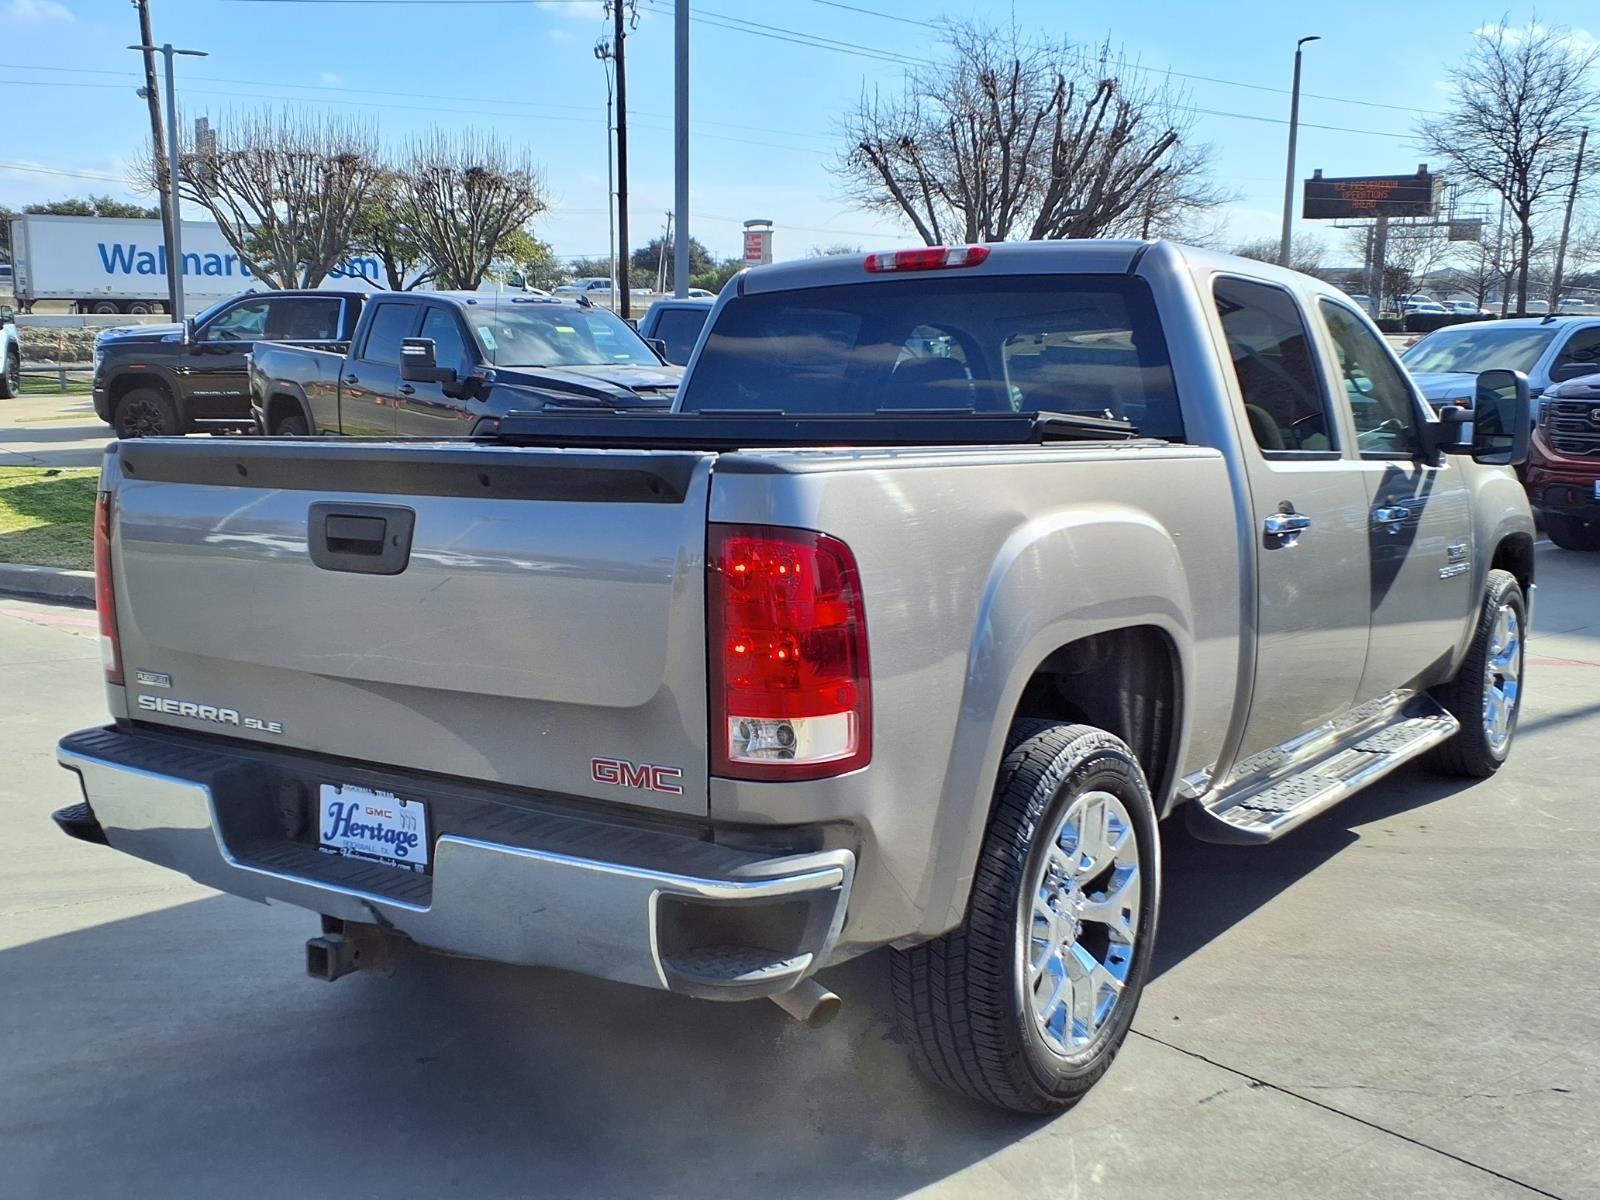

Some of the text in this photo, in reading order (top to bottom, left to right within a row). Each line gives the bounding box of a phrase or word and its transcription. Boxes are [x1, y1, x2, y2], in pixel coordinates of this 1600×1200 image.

[1343, 190, 1388, 199] OPERATIONS
[98, 242, 252, 278] Walmart
[138, 694, 283, 734] SIERRA SLE
[592, 757, 683, 795] GMC
[323, 802, 418, 857] Heritage
[364, 806, 393, 819] GMC
